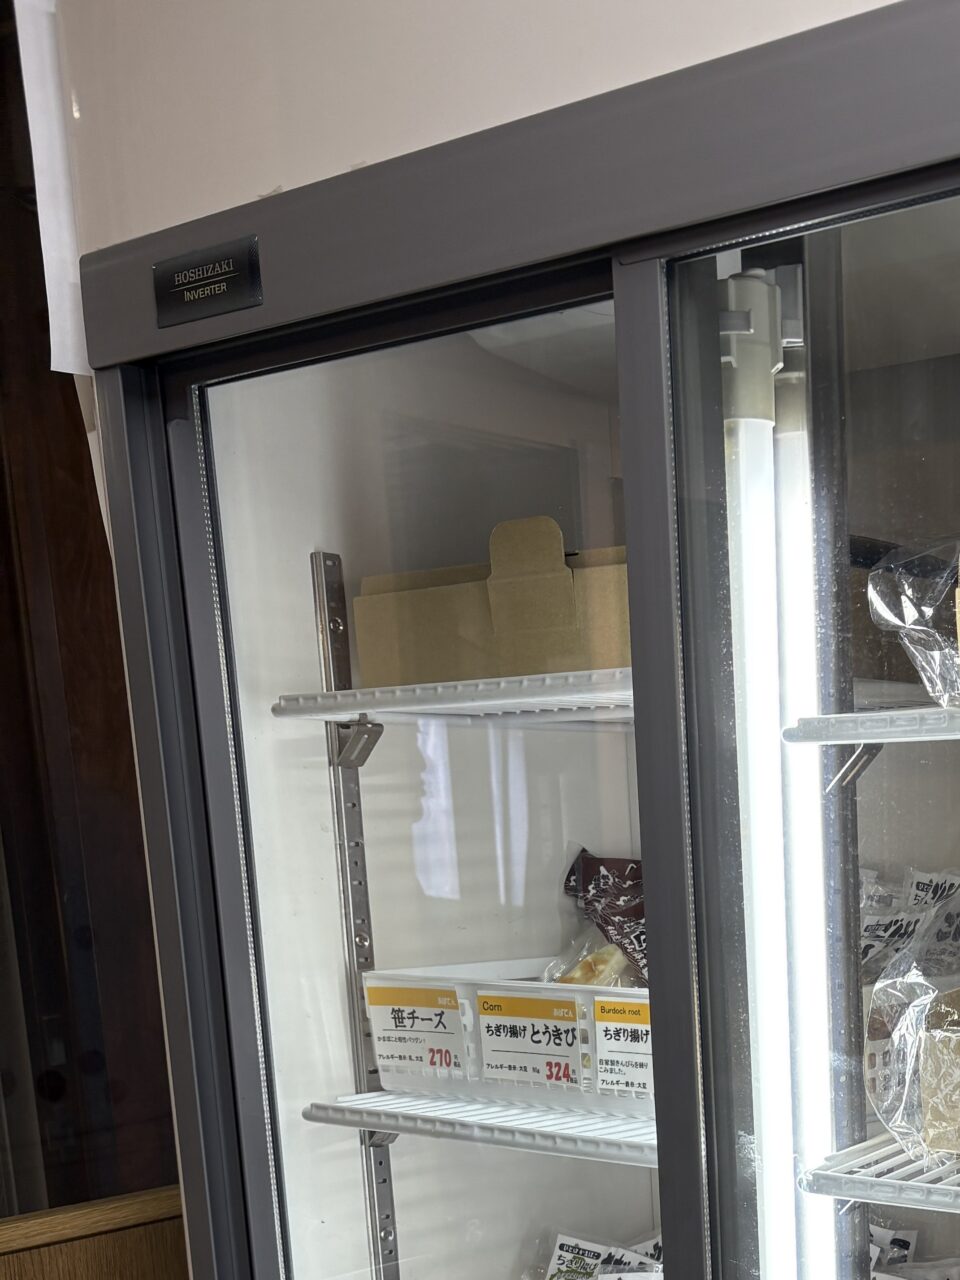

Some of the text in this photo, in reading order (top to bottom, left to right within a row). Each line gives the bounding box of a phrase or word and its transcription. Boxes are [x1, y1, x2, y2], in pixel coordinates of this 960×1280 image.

[174, 259, 235, 286] HOSHIZAKI
[184, 282, 228, 302] INVERTER
[482, 1001, 502, 1011] Corn
[600, 1005, 627, 1015] Burdock
[391, 1007, 447, 1030] 笹チーズ
[485, 1023, 577, 1047] ちぎり揚げ とうきび
[603, 1026, 650, 1044] ちぎり揚げ
[428, 1048, 452, 1068] 270
[545, 1061, 571, 1083] 324
